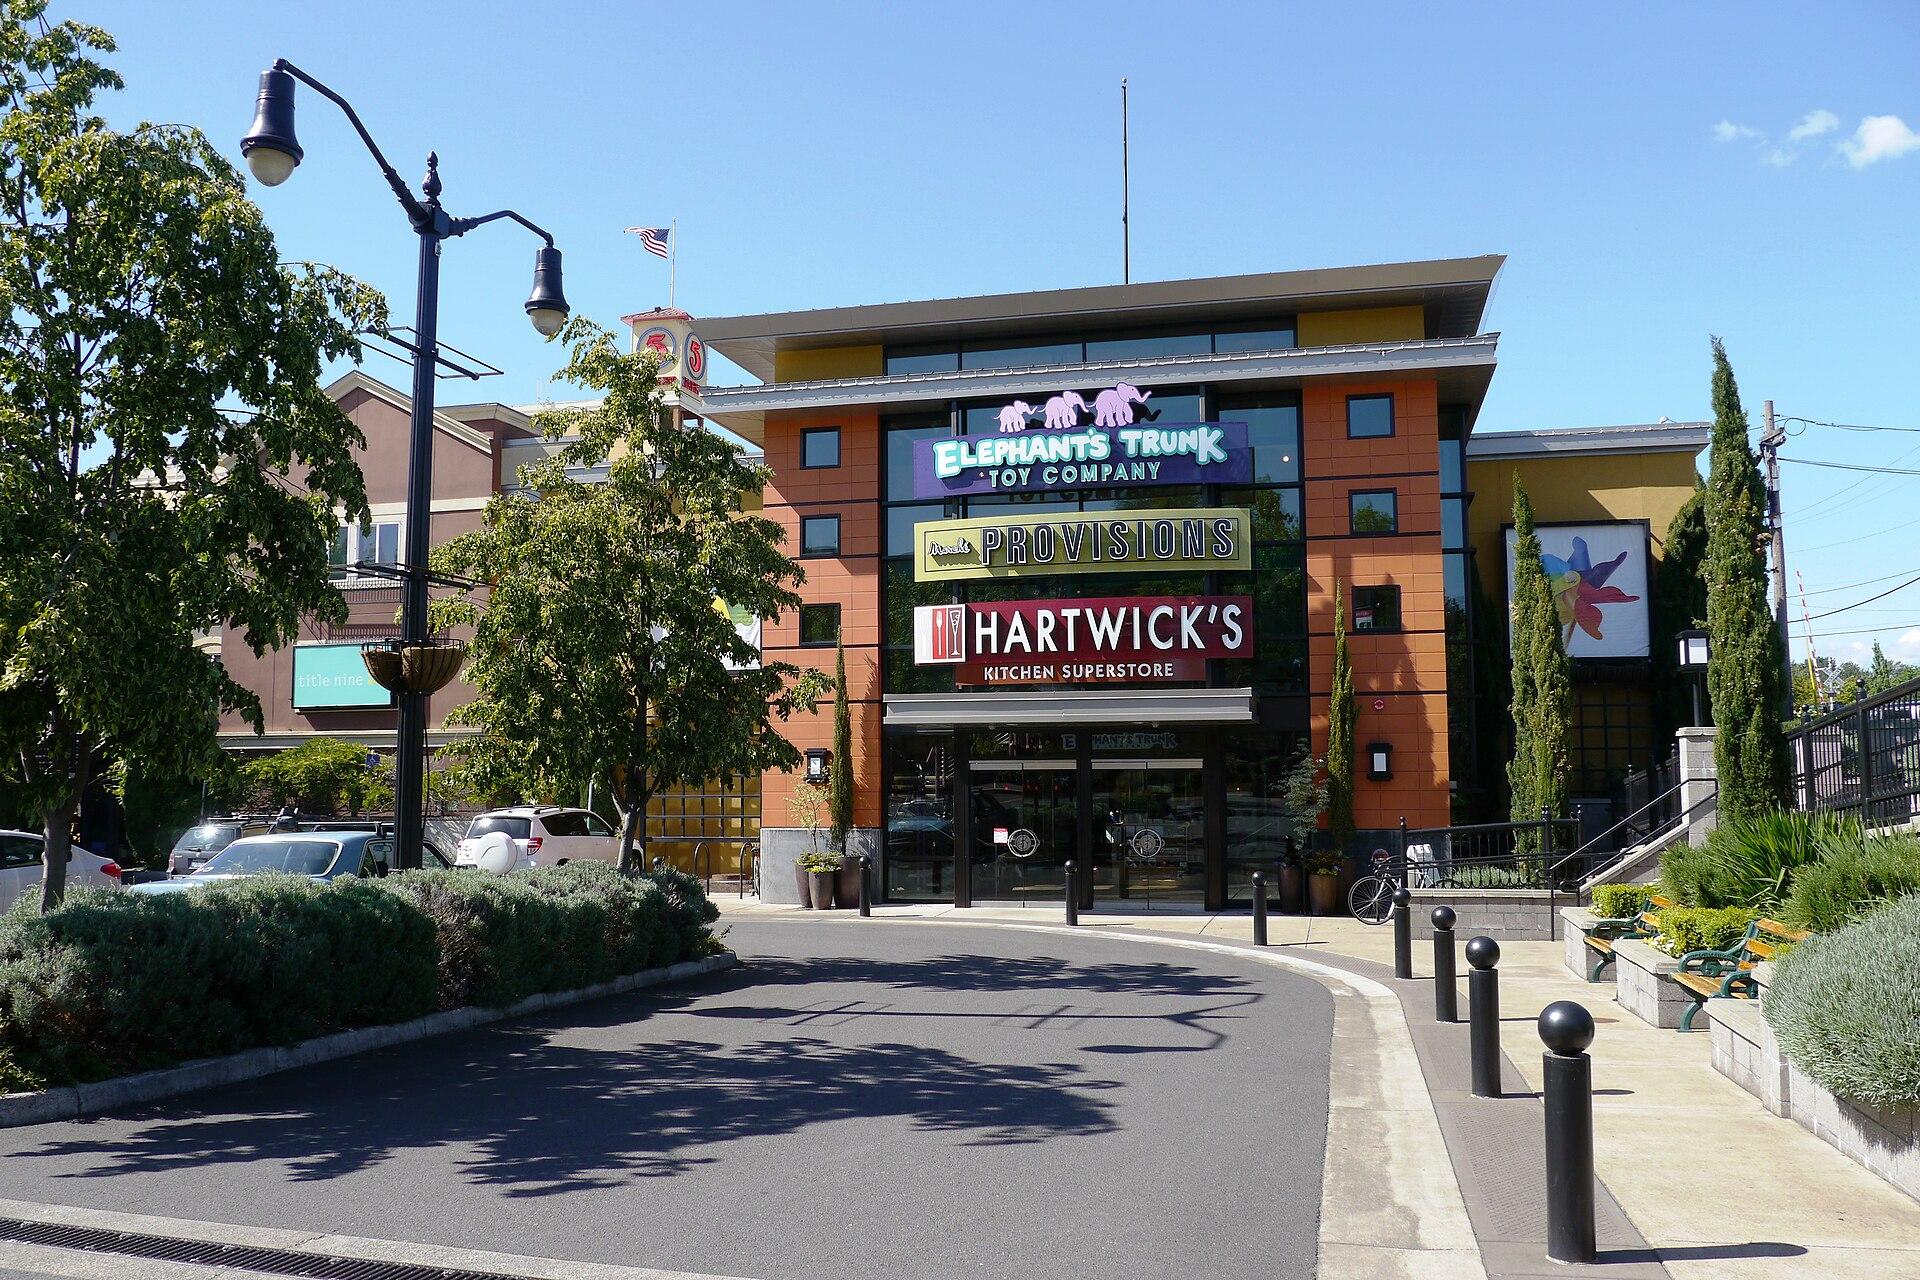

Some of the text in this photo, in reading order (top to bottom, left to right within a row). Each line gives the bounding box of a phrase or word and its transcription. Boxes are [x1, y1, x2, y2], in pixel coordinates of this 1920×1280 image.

[689, 340, 702, 372] 5
[933, 424, 1227, 479] ELEPHANT'S TRUNK
[988, 462, 1161, 487] TOY COMPANY
[981, 518, 1235, 566] PROVISIONS
[975, 604, 1243, 654] HARTWICK'S
[299, 674, 364, 688] title nine
[984, 662, 1174, 681] KITCHEN SUPERSTORE
